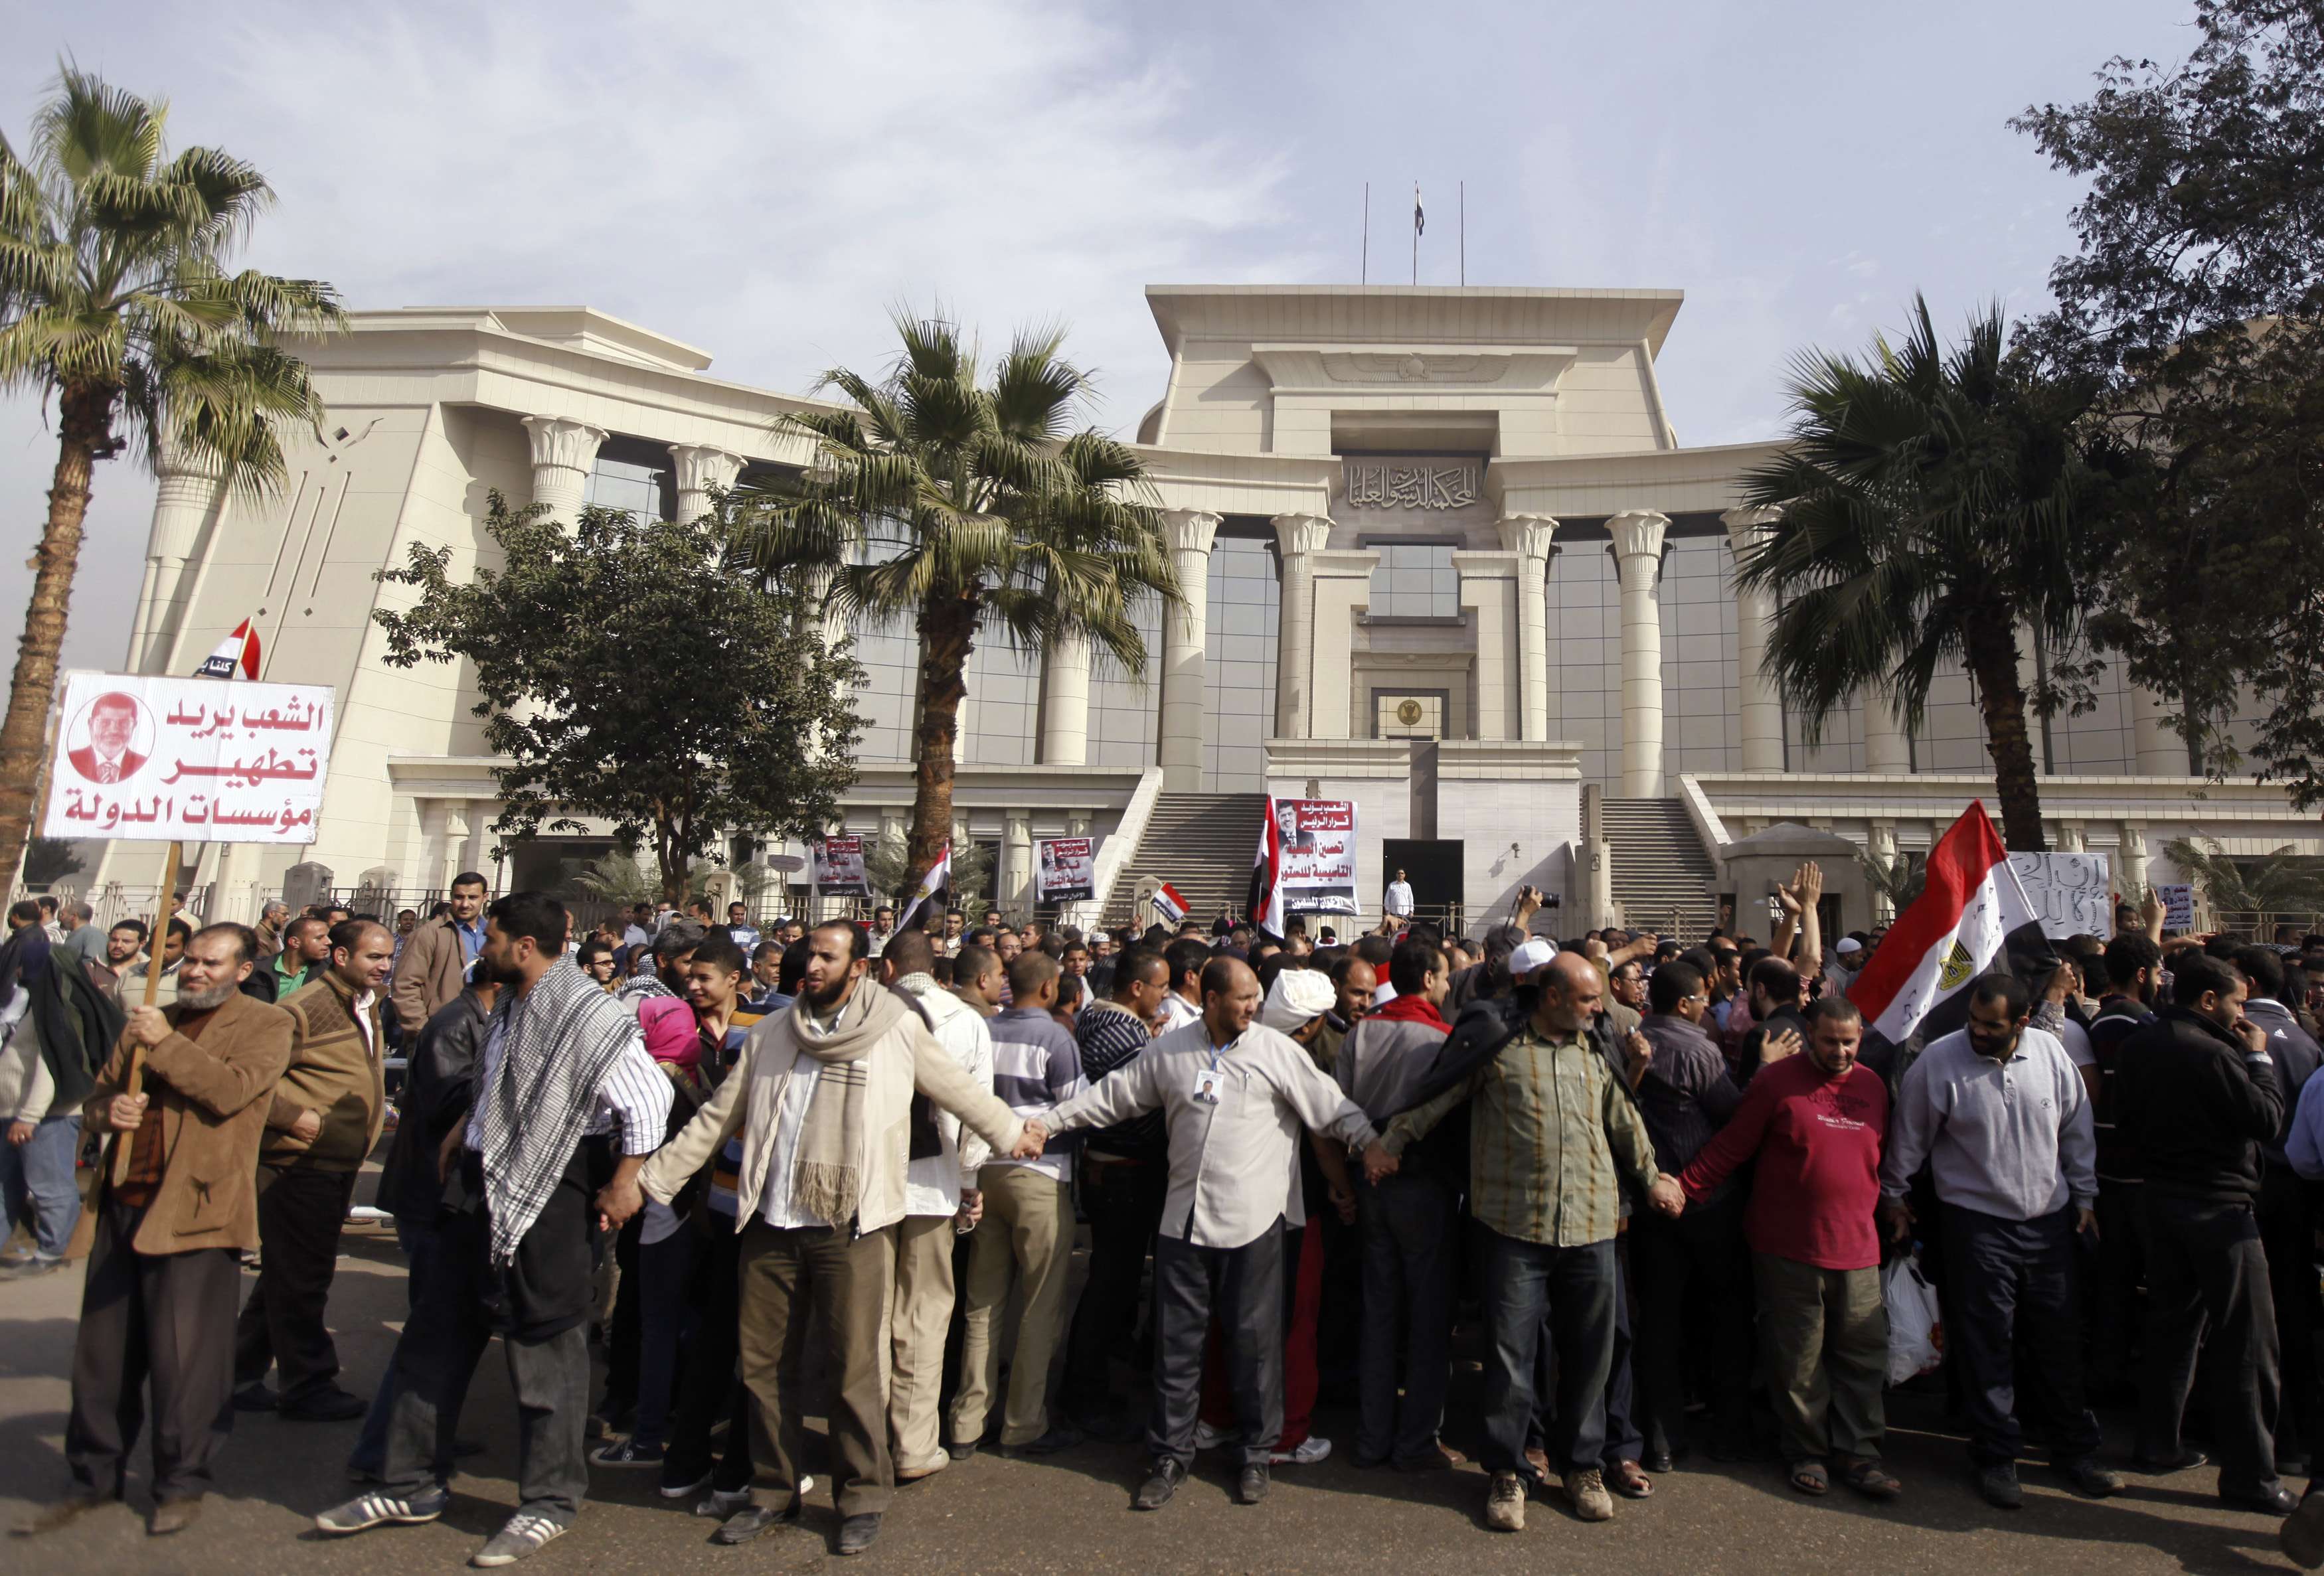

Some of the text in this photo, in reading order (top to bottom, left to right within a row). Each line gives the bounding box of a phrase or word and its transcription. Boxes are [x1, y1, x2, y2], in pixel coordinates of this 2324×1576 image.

[1349, 465, 1475, 510] المحكمة الدستورية العليا
[167, 694, 324, 740] الشعب يريد
[159, 747, 318, 789] تطهير
[65, 788, 173, 830] الدولة
[182, 793, 313, 835] مؤسسات
[1300, 815, 1349, 828] قرار الرئيس
[1301, 801, 1349, 815] الشعب يؤيد
